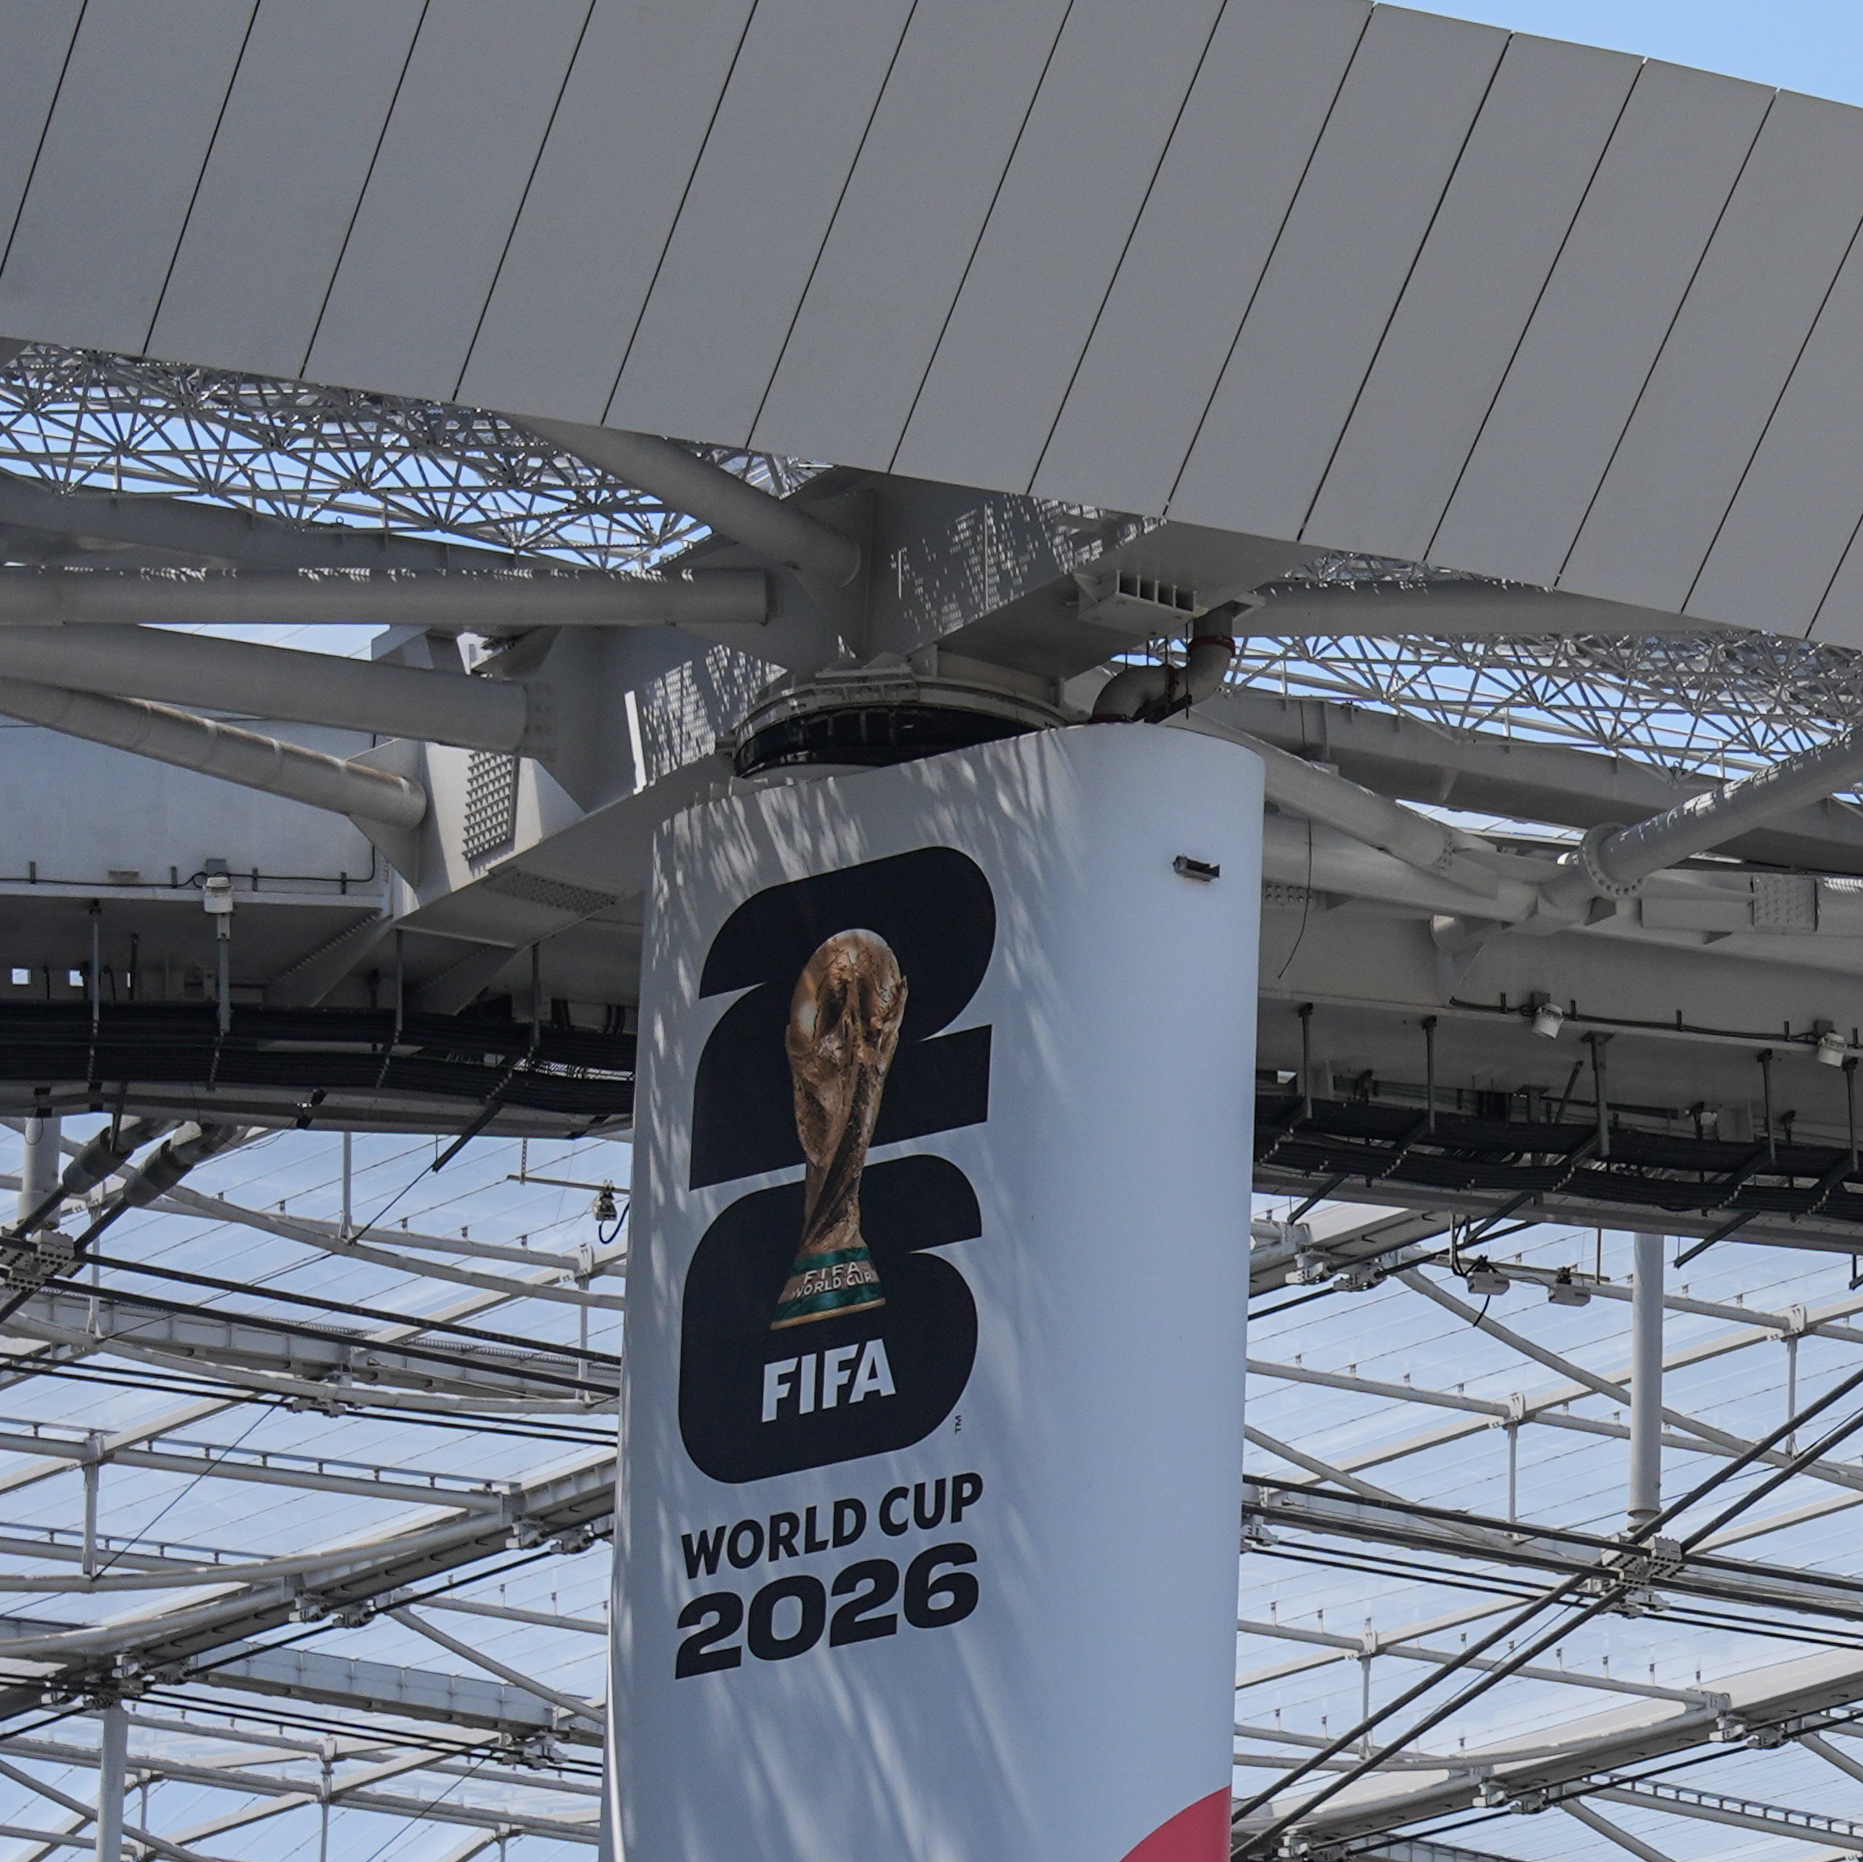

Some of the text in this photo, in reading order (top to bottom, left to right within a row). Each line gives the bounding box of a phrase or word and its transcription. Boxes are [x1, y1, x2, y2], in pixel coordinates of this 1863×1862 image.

[792, 1271, 872, 1298] WORLD CUP
[803, 1261, 861, 1285] FIFA
[761, 1337, 897, 1423] FIFA
[680, 1471, 984, 1580] WORLD CUP
[674, 1541, 980, 1681] 2026
